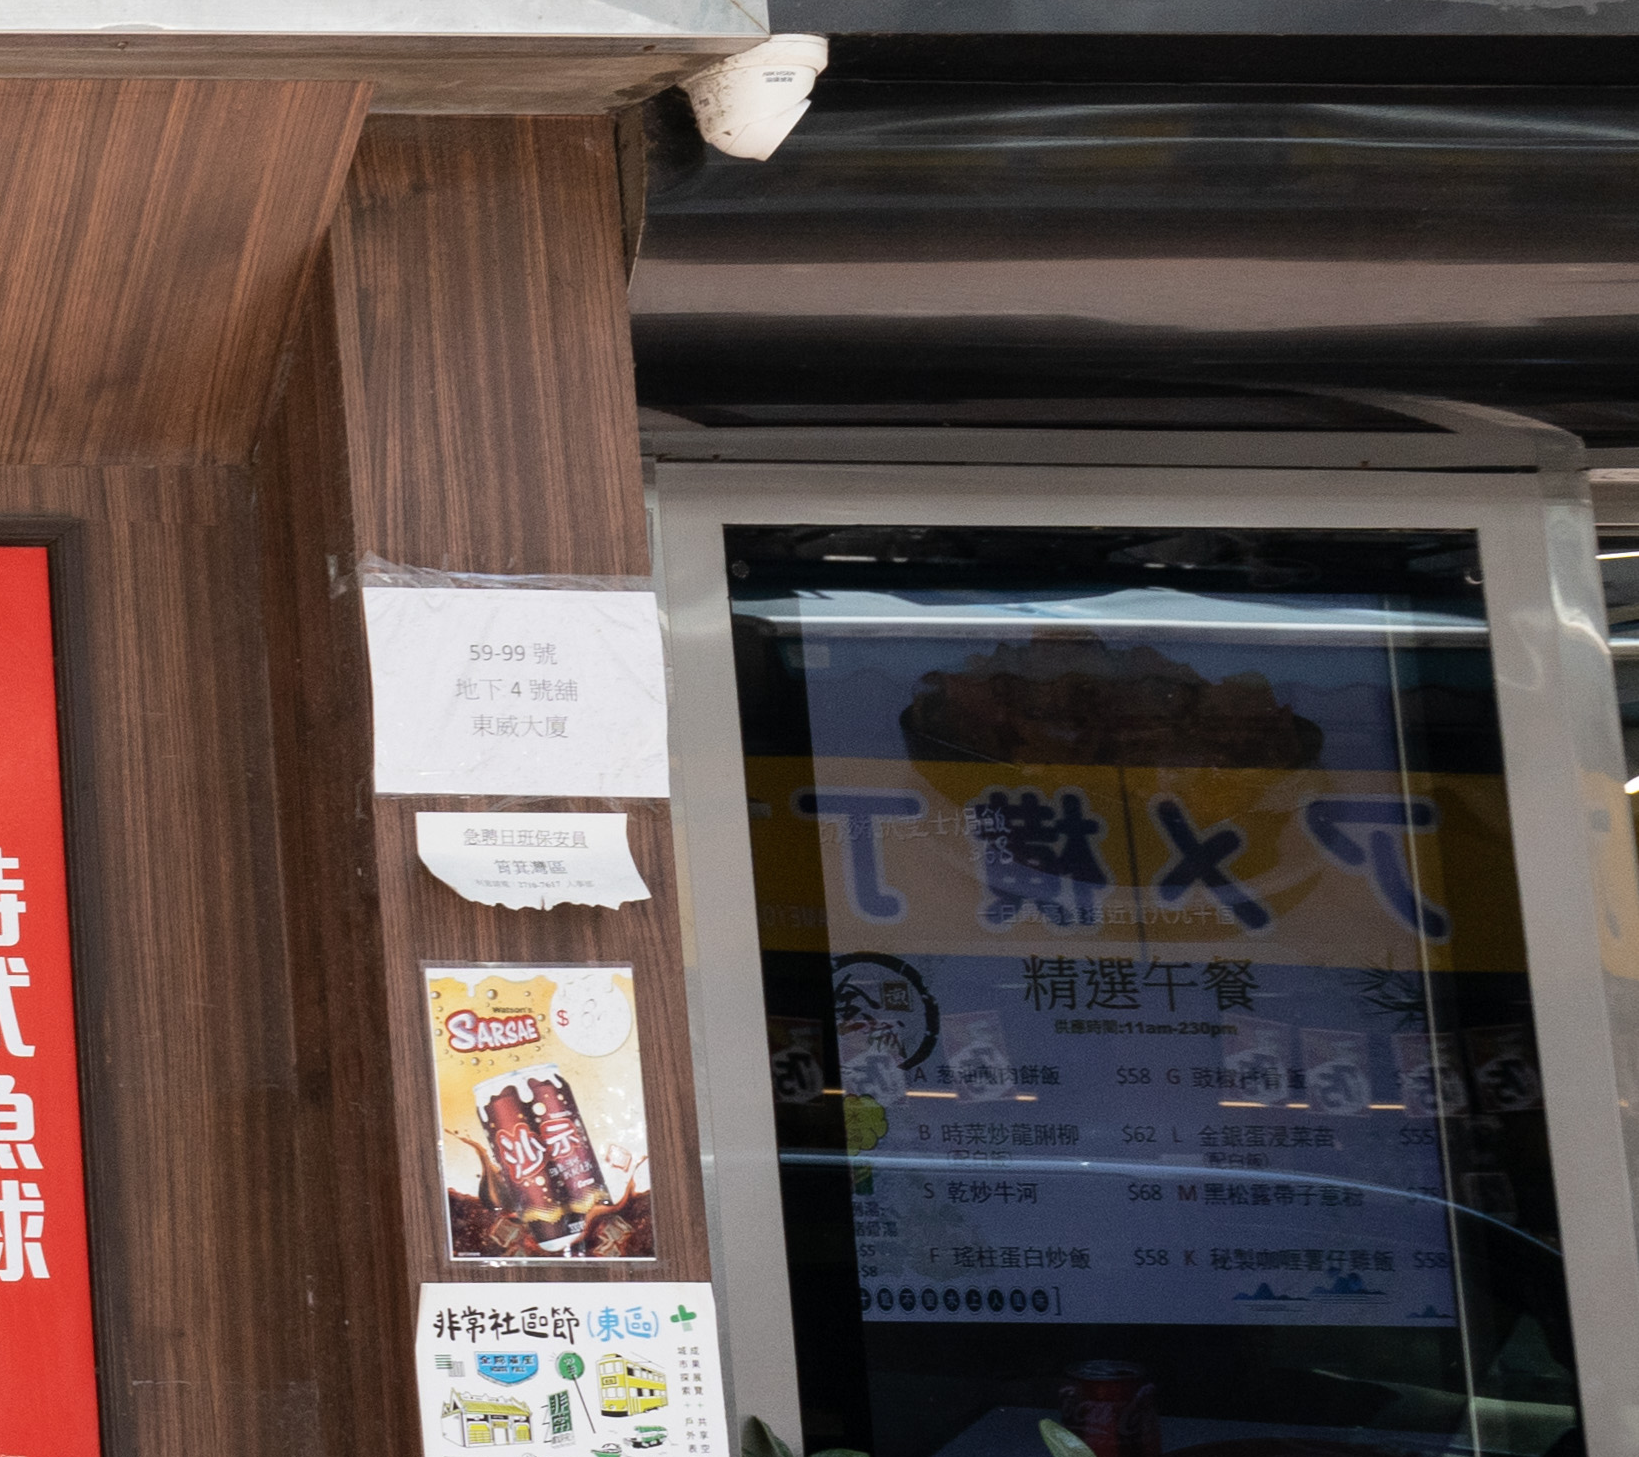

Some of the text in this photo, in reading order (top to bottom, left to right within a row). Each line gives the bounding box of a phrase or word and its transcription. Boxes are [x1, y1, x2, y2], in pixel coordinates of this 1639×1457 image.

[469, 643, 558, 666] 59-99 號
[455, 678, 503, 702] 地下
[511, 681, 522, 697] 4
[471, 715, 569, 739] 東威大廈
[1021, 954, 1258, 1017] 精選午餐
[448, 1011, 538, 1050] SARSAE
[1121, 1124, 1157, 1145] $62
[1127, 1183, 1163, 1204] $68
[1134, 1248, 1170, 1269] $58
[433, 1306, 580, 1345] 非常社區節
